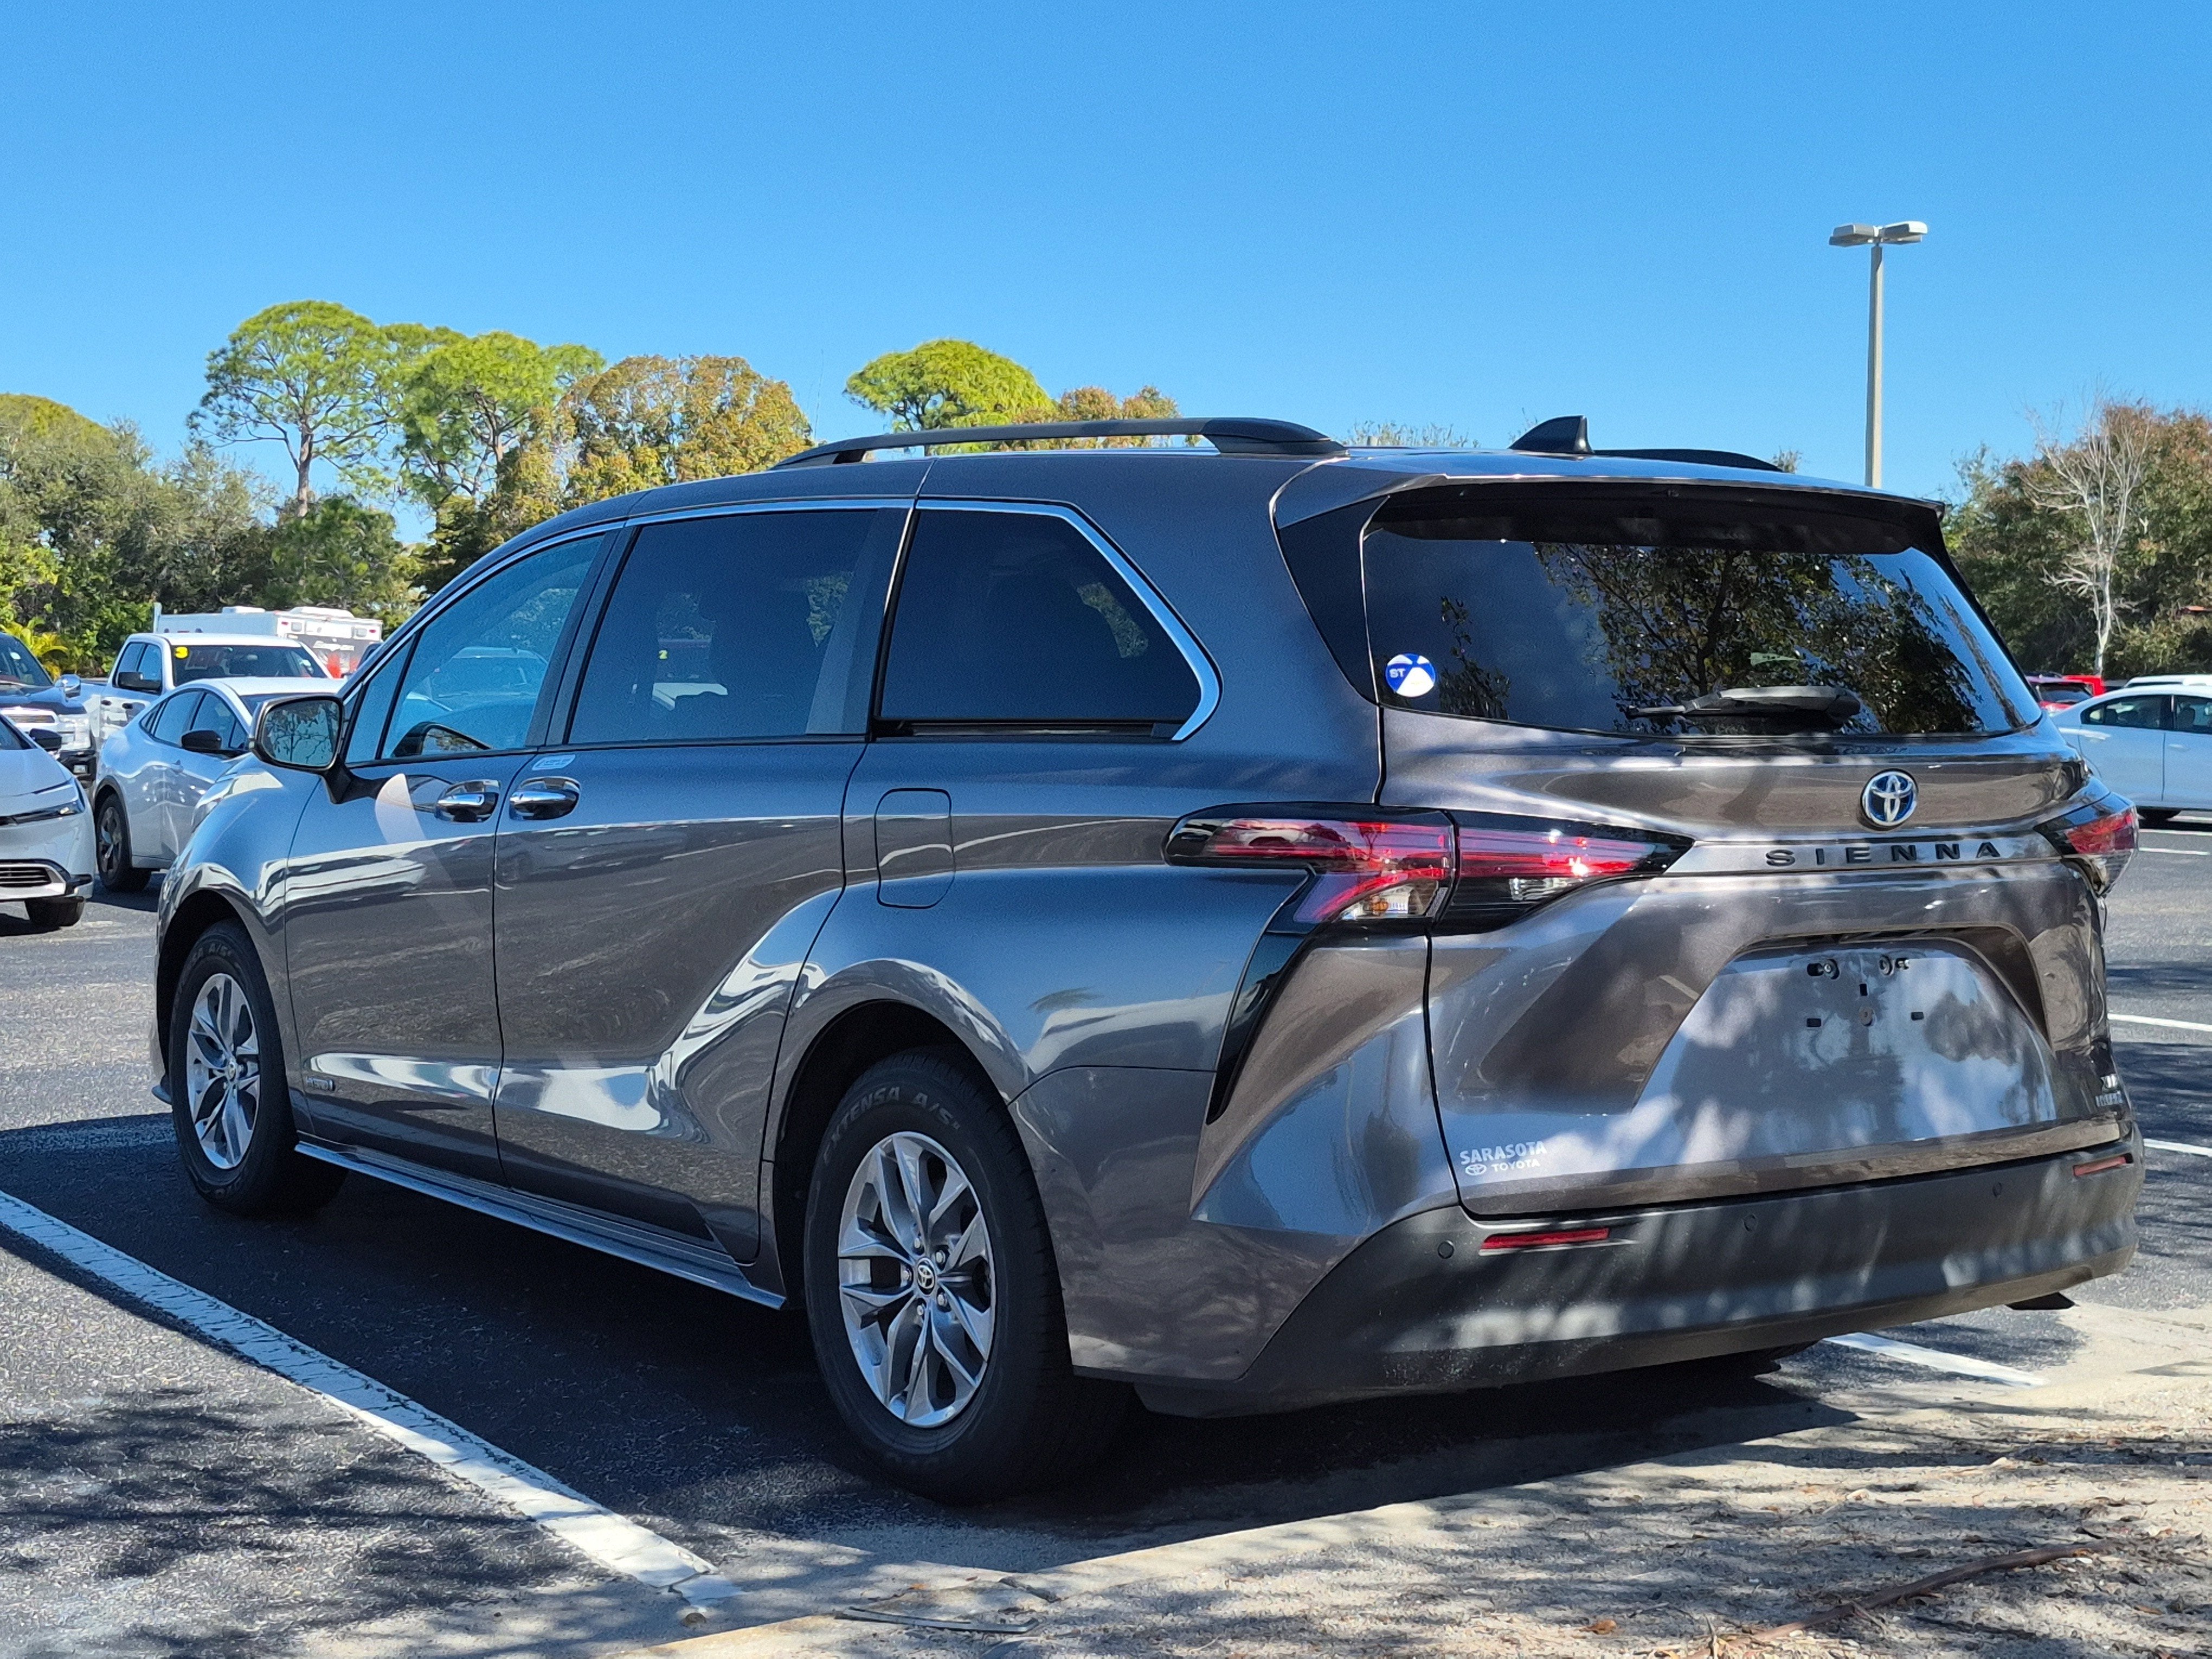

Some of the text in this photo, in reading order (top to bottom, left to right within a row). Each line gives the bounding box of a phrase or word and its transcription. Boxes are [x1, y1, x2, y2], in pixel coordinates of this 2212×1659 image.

[1388, 668, 1406, 678] ST
[1765, 841, 2001, 866] SIENNA
[1459, 1141, 1547, 1165] SARASOTA
[1491, 1159, 1541, 1172] TOYOTA
